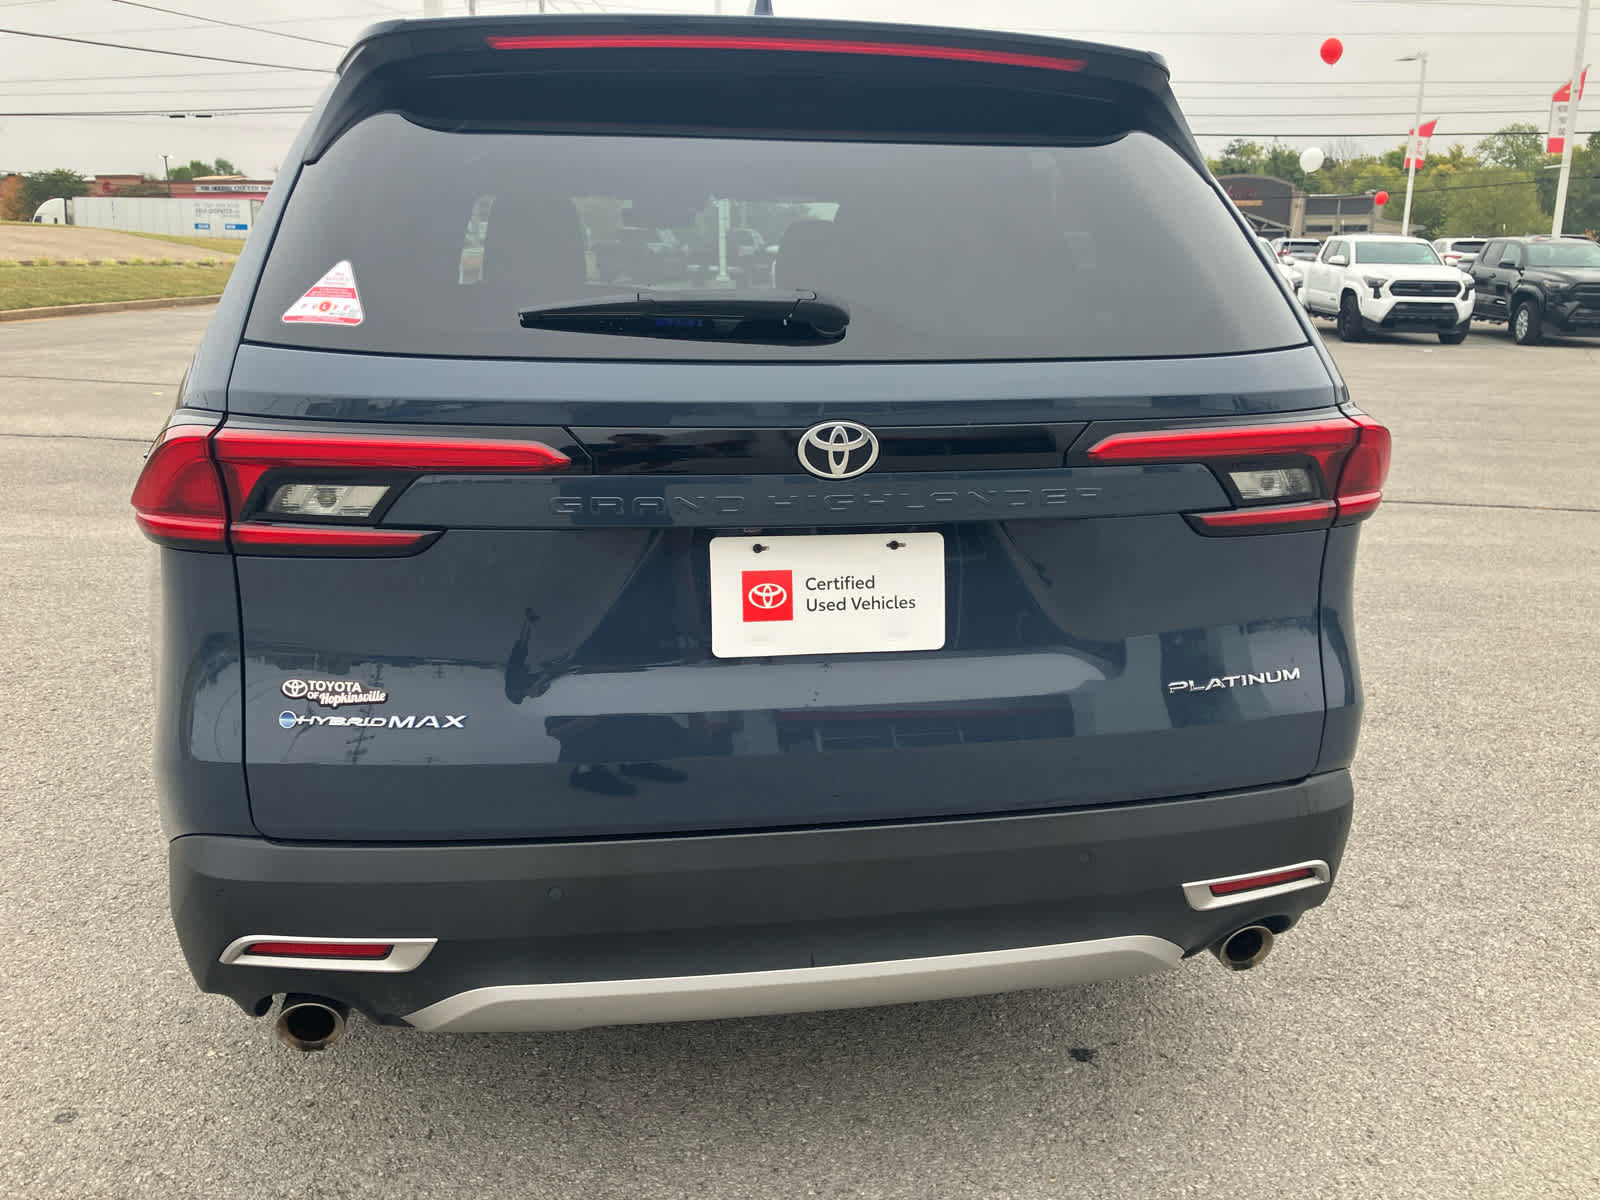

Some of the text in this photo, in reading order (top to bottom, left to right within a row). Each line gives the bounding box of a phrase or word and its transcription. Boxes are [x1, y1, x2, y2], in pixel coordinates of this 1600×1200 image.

[550, 487, 1104, 514] GRAND HIGHLANDER
[805, 575, 875, 591] Certified
[806, 595, 916, 612] Used Vehicles
[308, 680, 362, 692] TOYOTA
[1168, 667, 1301, 694] PLATINUM
[307, 691, 385, 707] OF Hopkinsville
[296, 714, 467, 728] HYBRID MAX
